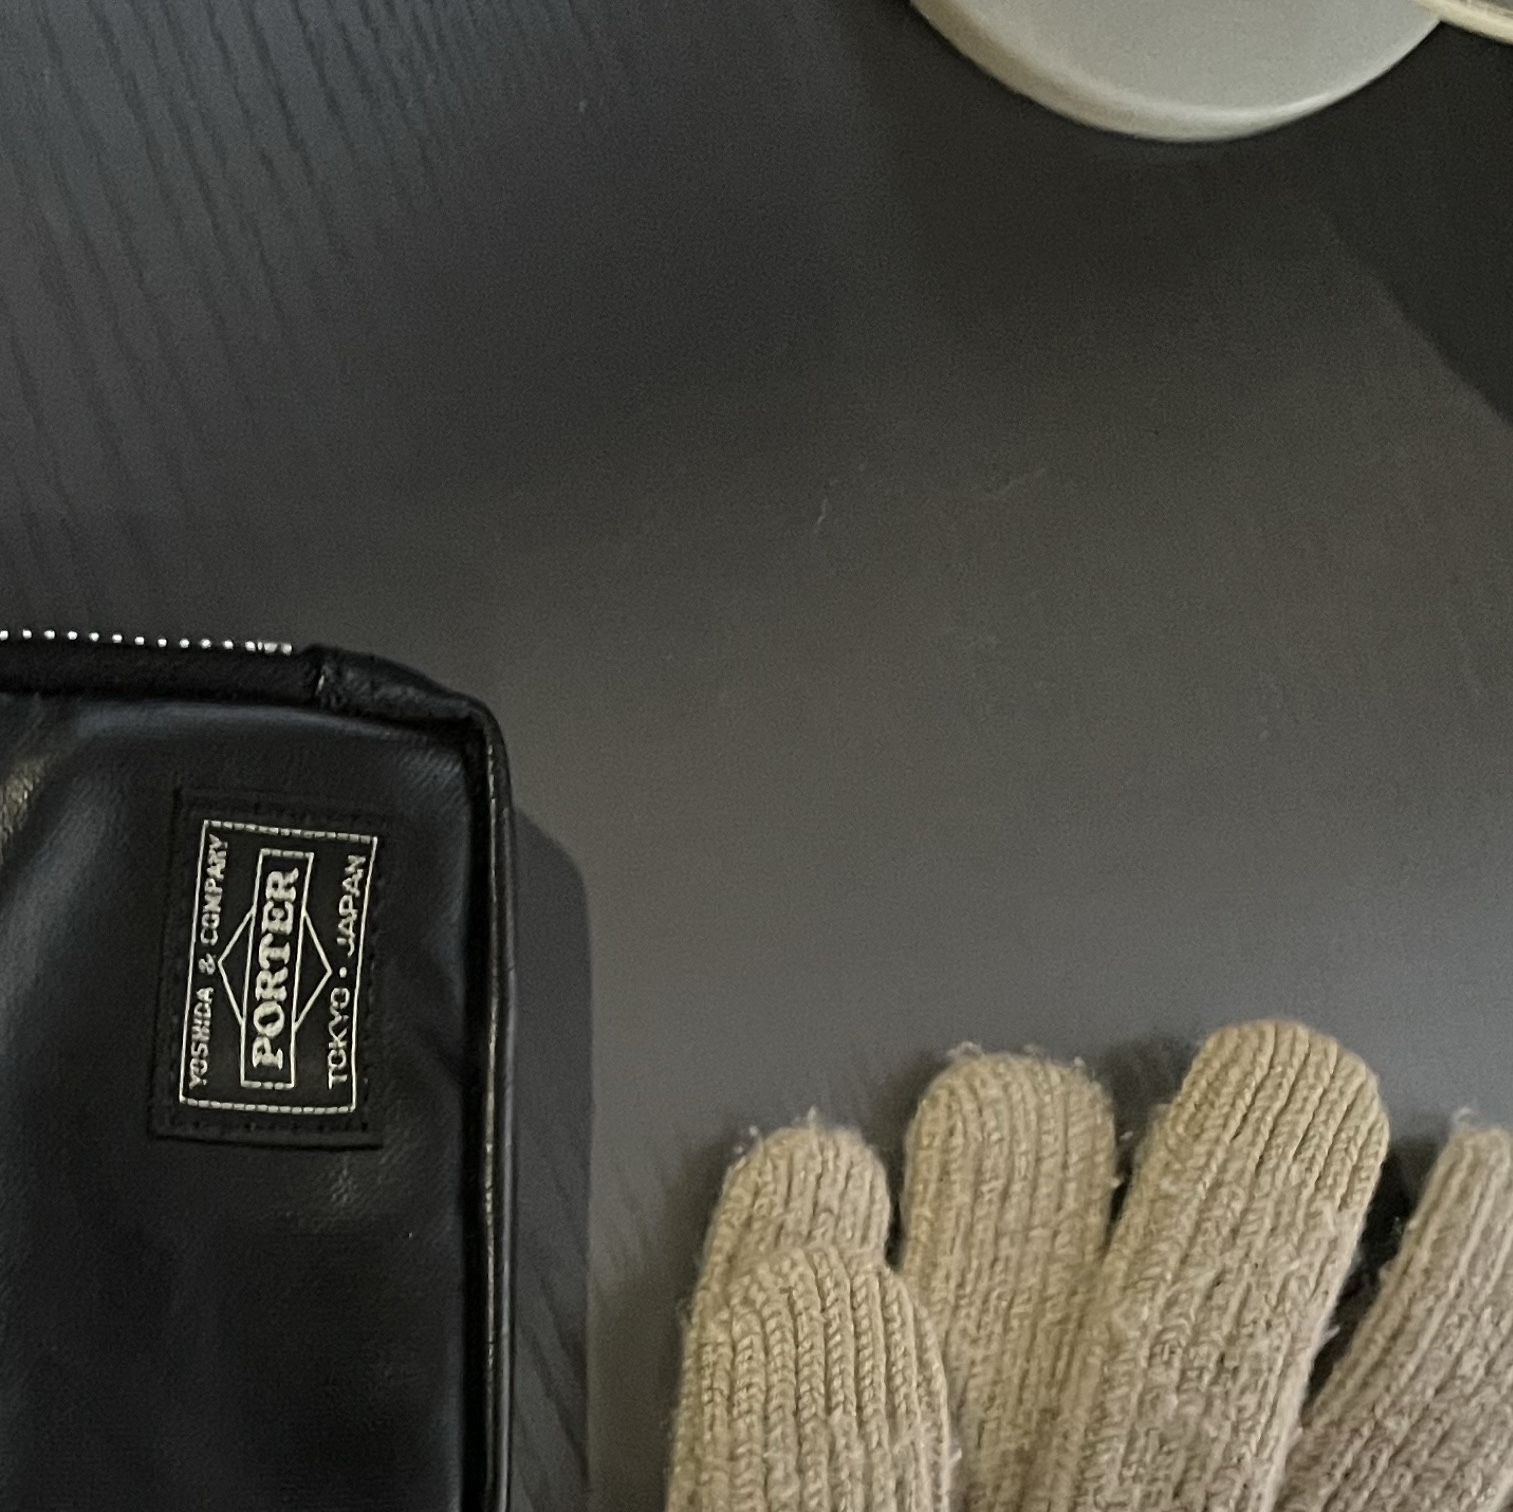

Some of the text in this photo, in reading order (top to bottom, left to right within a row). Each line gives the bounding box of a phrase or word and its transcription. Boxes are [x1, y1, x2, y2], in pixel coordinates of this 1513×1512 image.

[200, 833, 228, 946] COMPANY
[252, 867, 299, 1069] PORTER
[188, 987, 215, 1090] YOSHIDA
[327, 854, 367, 1090] TOKYO JAPAN
